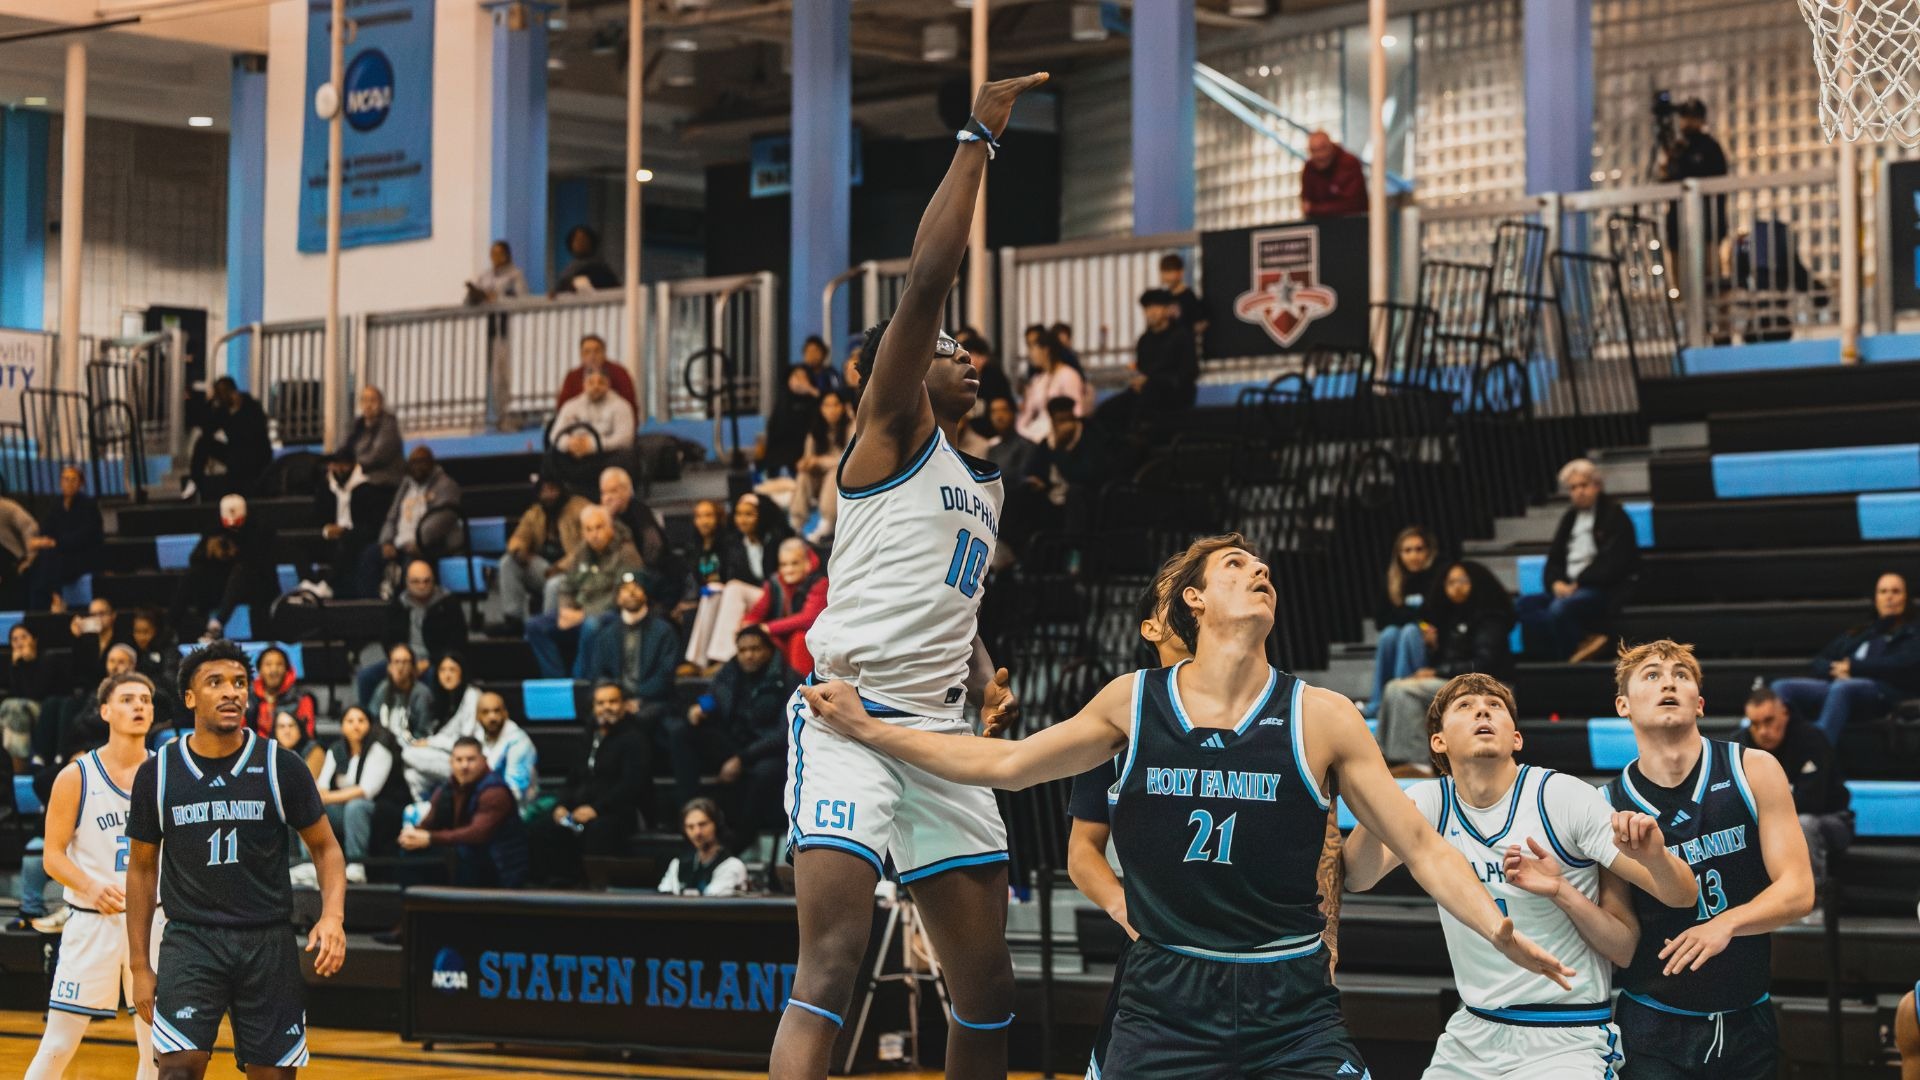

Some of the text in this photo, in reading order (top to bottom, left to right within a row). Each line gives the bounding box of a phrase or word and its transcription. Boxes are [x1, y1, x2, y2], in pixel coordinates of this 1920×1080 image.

[944, 528, 989, 599] 10
[1146, 767, 1281, 801] HOLY FAMILY
[172, 801, 266, 826] HOLY FAMILY
[815, 799, 856, 831] CSI
[206, 827, 239, 866] 11
[1183, 809, 1238, 865] 21
[1681, 825, 1747, 865] FAMILY
[1695, 868, 1728, 921] 13
[57, 980, 80, 1000] CSI
[432, 969, 468, 989] NCAA
[479, 950, 635, 1005] STATEN
